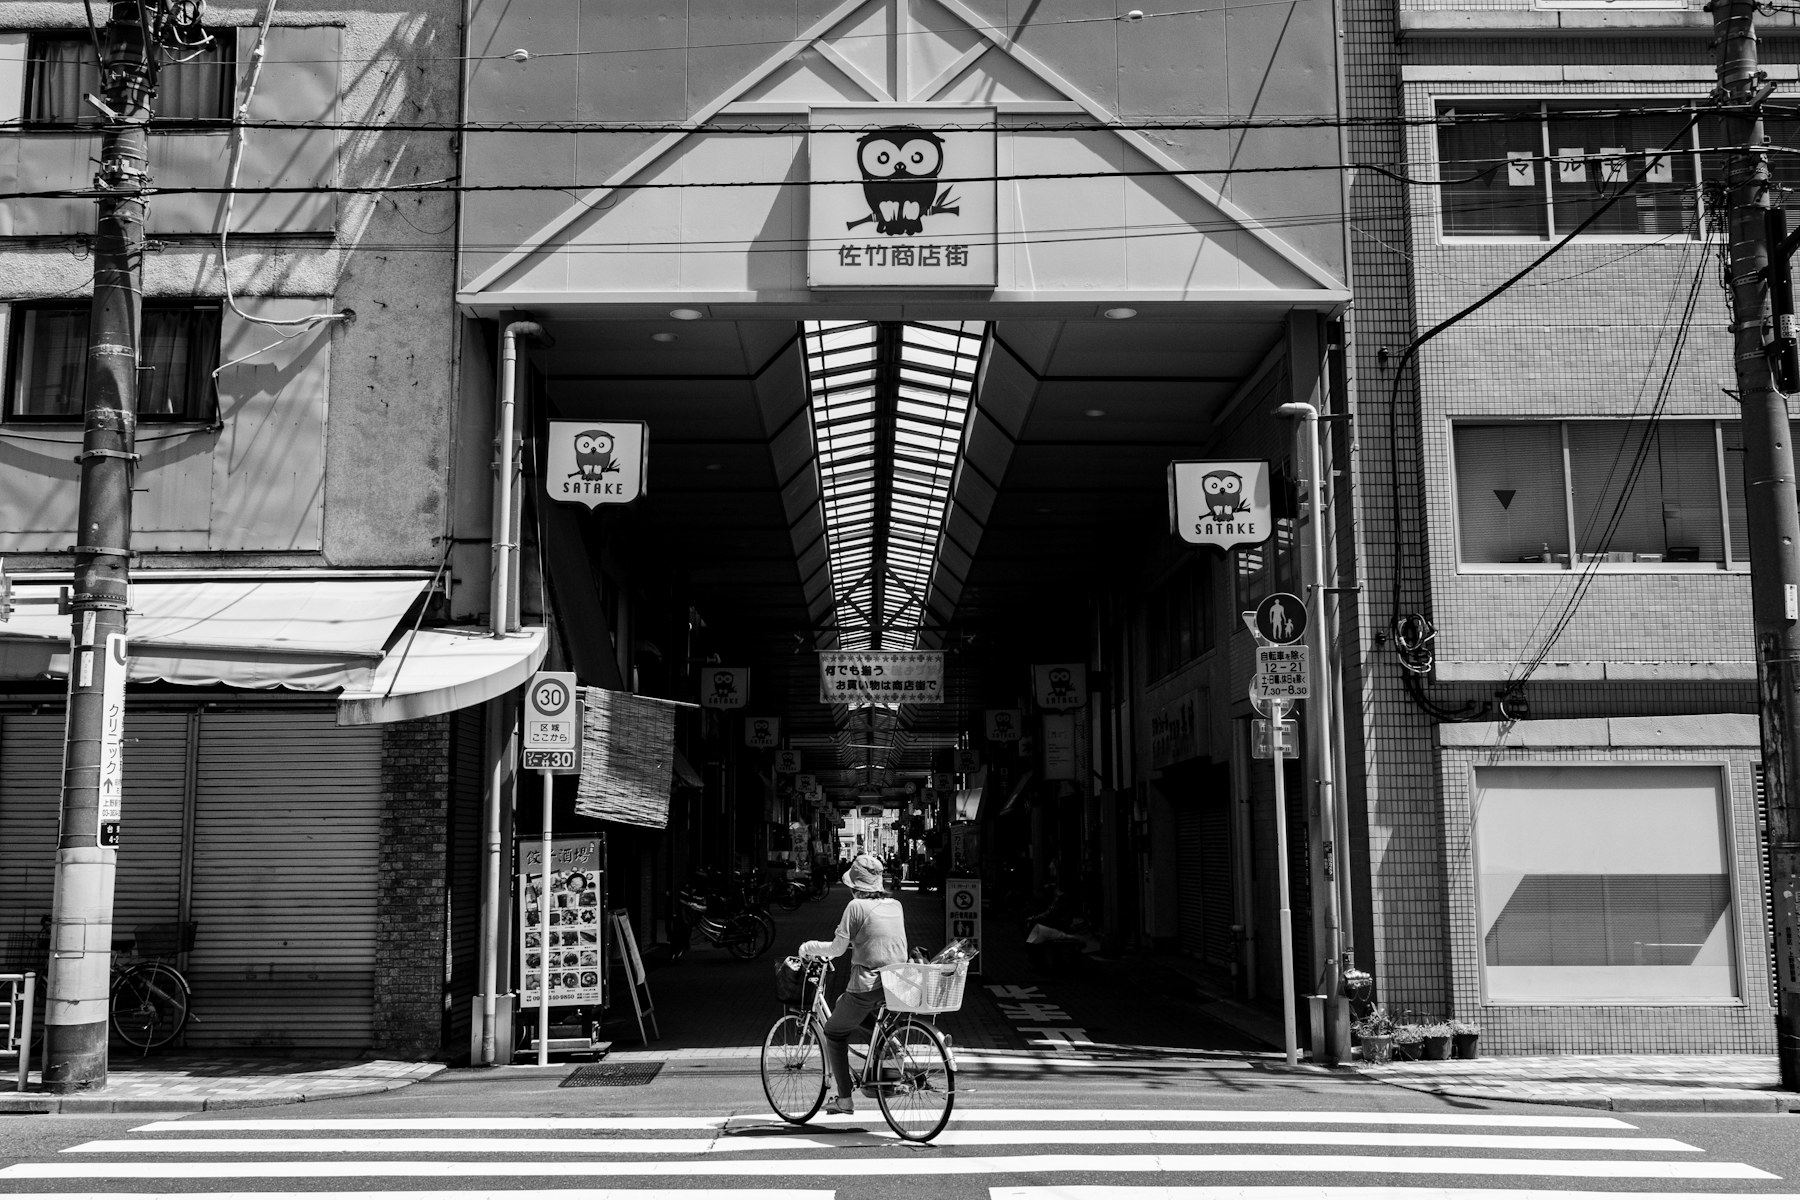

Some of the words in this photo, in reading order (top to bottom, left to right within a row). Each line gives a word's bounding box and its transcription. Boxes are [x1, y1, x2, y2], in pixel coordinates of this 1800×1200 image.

[838, 244, 968, 266] 佐竹商店街
[562, 482, 623, 495] SATAKE
[1195, 522, 1255, 535] SATAKE
[1260, 650, 1305, 661] 自転車を除く
[825, 665, 884, 676] 何でも揃う
[835, 680, 937, 691] お買い物は商店街で
[540, 689, 562, 706] 30
[540, 723, 560, 732] 区域
[106, 703, 120, 775] クリニック
[532, 733, 568, 742] ここから
[551, 752, 572, 767] 30
